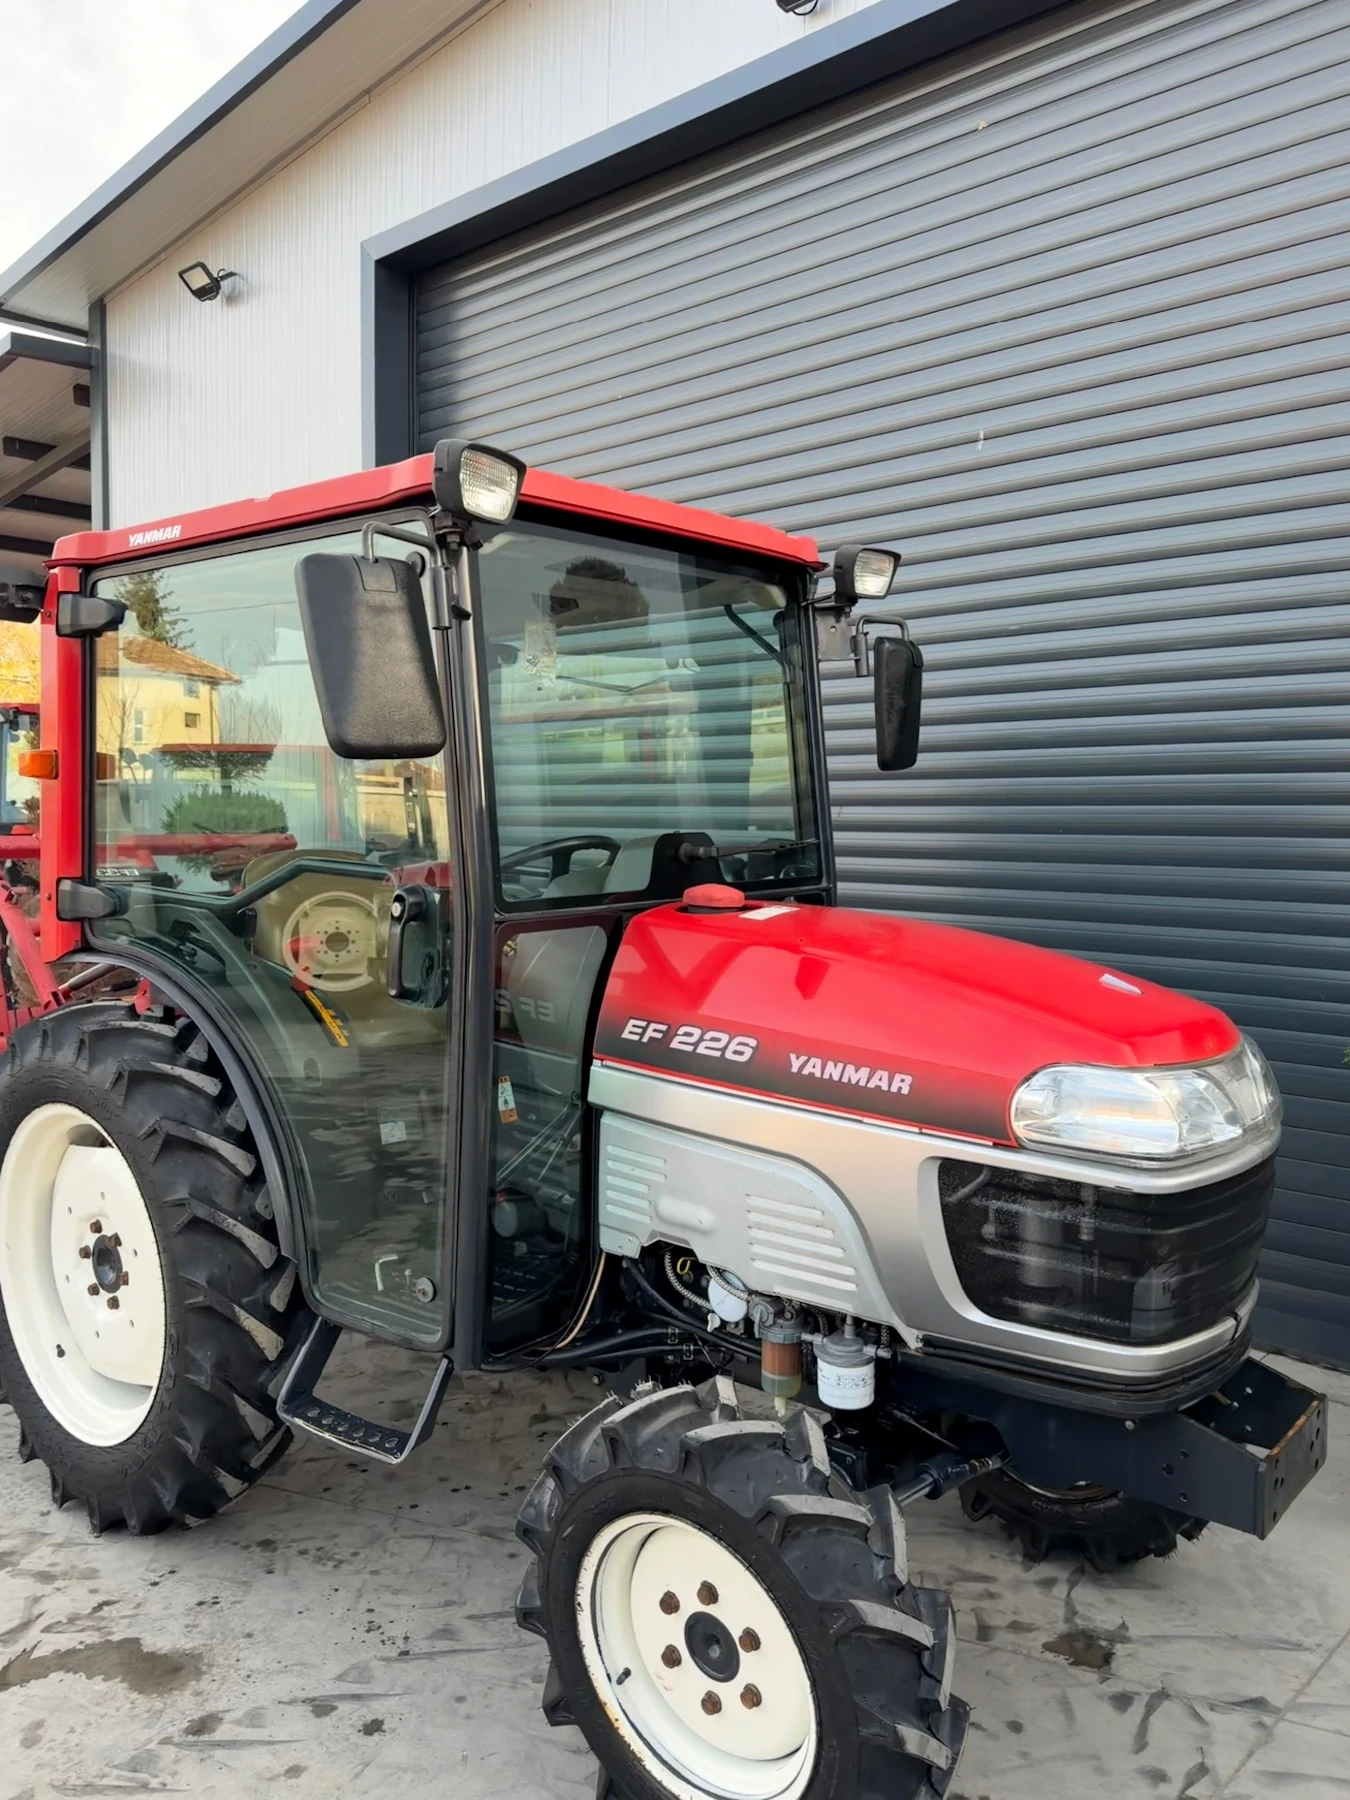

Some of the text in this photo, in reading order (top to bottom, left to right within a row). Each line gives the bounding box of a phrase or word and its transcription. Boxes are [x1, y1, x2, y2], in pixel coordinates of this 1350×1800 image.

[128, 525, 182, 547] YANMAR
[620, 1018, 758, 1063] EF 226
[788, 1053, 913, 1095] YANMAR
